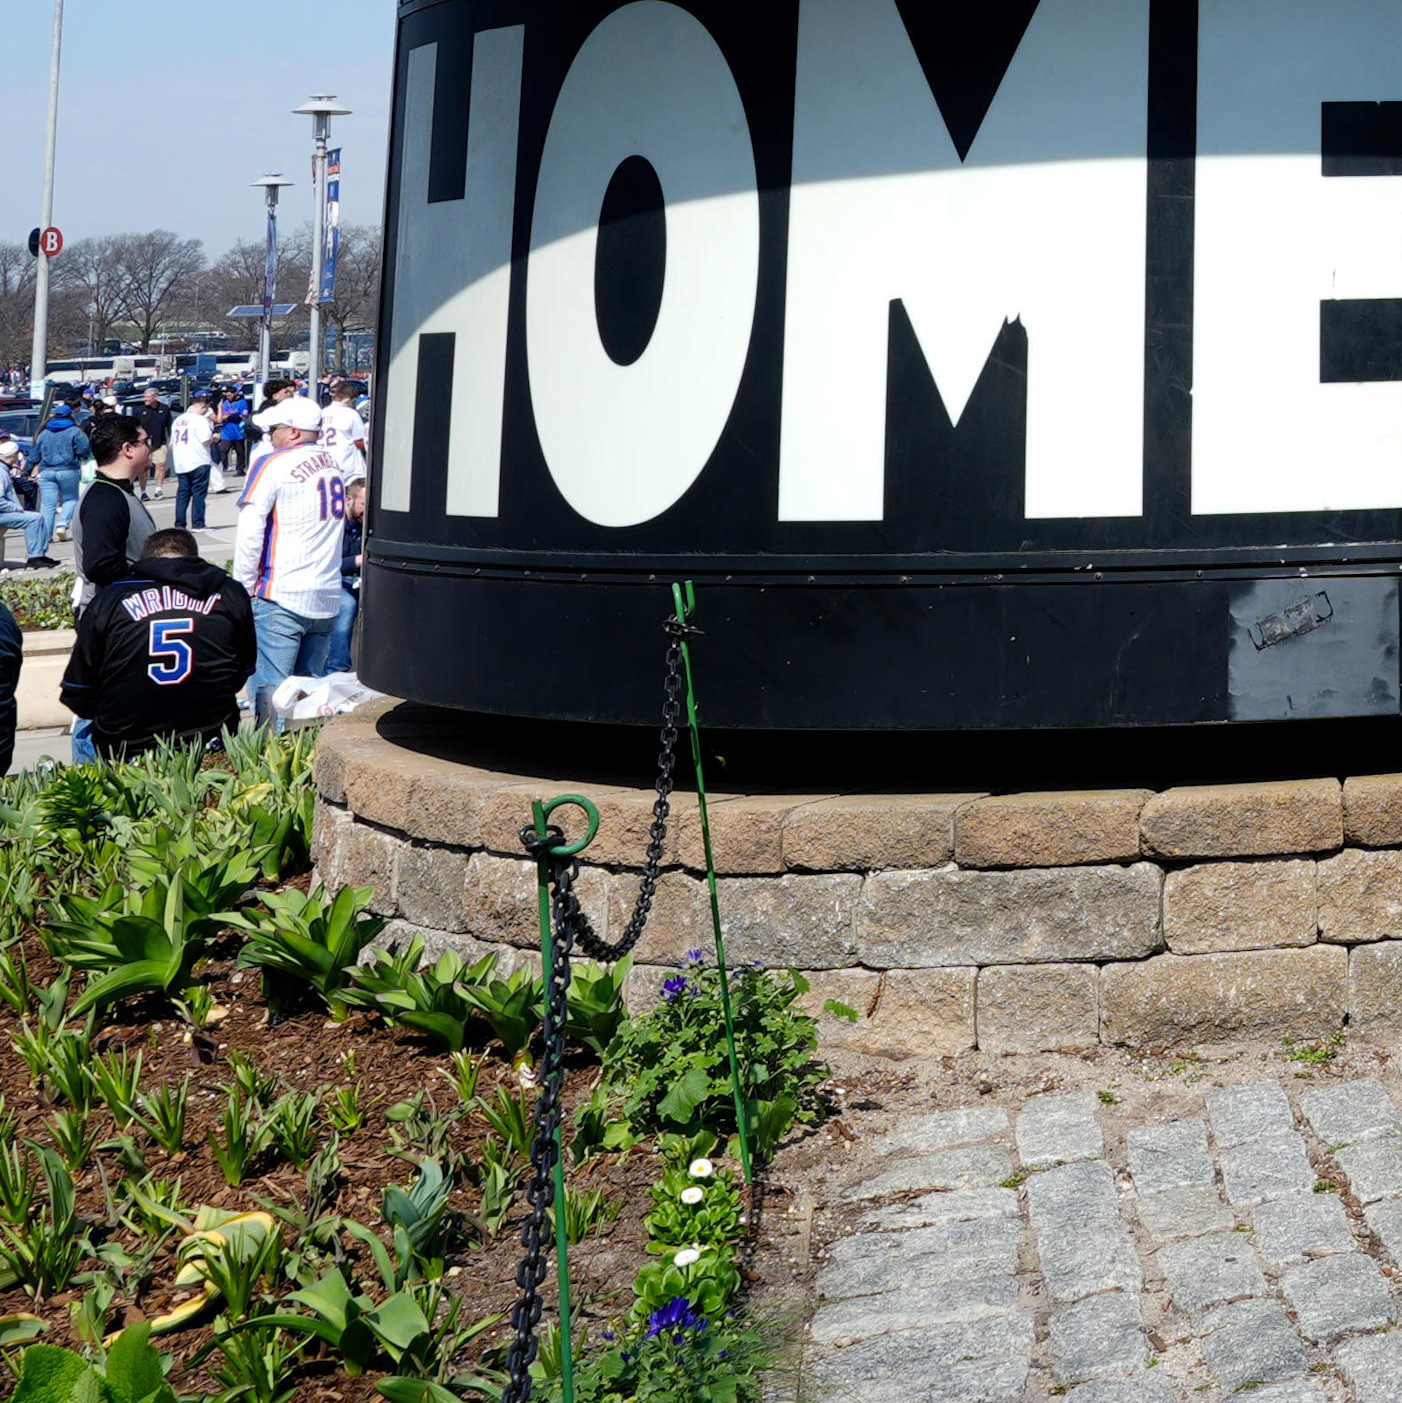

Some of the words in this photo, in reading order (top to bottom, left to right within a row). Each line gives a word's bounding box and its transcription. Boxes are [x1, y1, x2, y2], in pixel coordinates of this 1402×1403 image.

[45, 231, 58, 252] B
[316, 477, 345, 521] 18
[148, 618, 194, 685] 5
